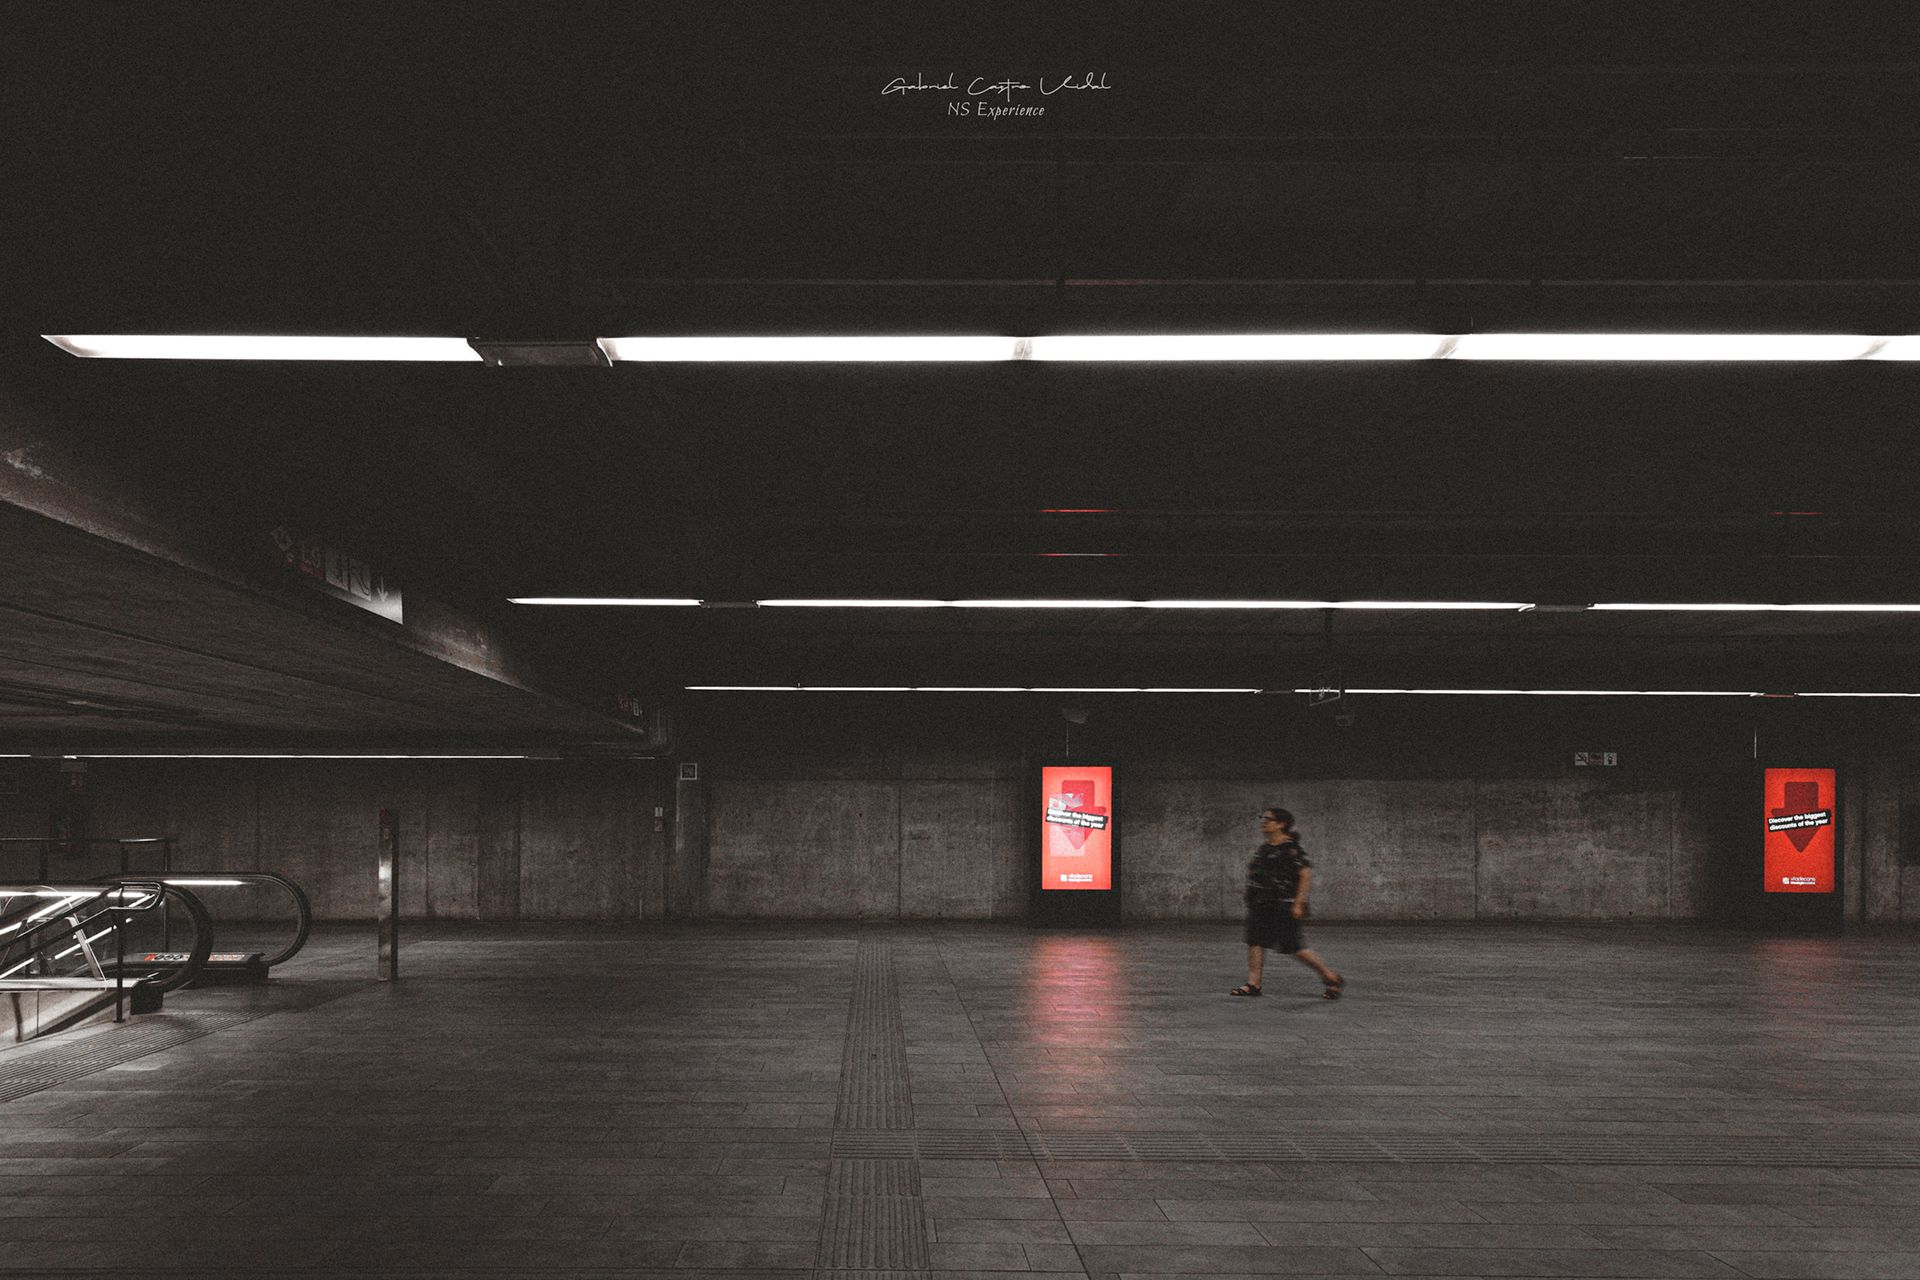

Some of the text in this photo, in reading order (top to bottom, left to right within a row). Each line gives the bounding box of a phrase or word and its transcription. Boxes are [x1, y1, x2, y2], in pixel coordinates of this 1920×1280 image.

[1768, 816, 1793, 824] Discover
[1804, 812, 1826, 820] biggest
[1769, 822, 1797, 831] discounts
